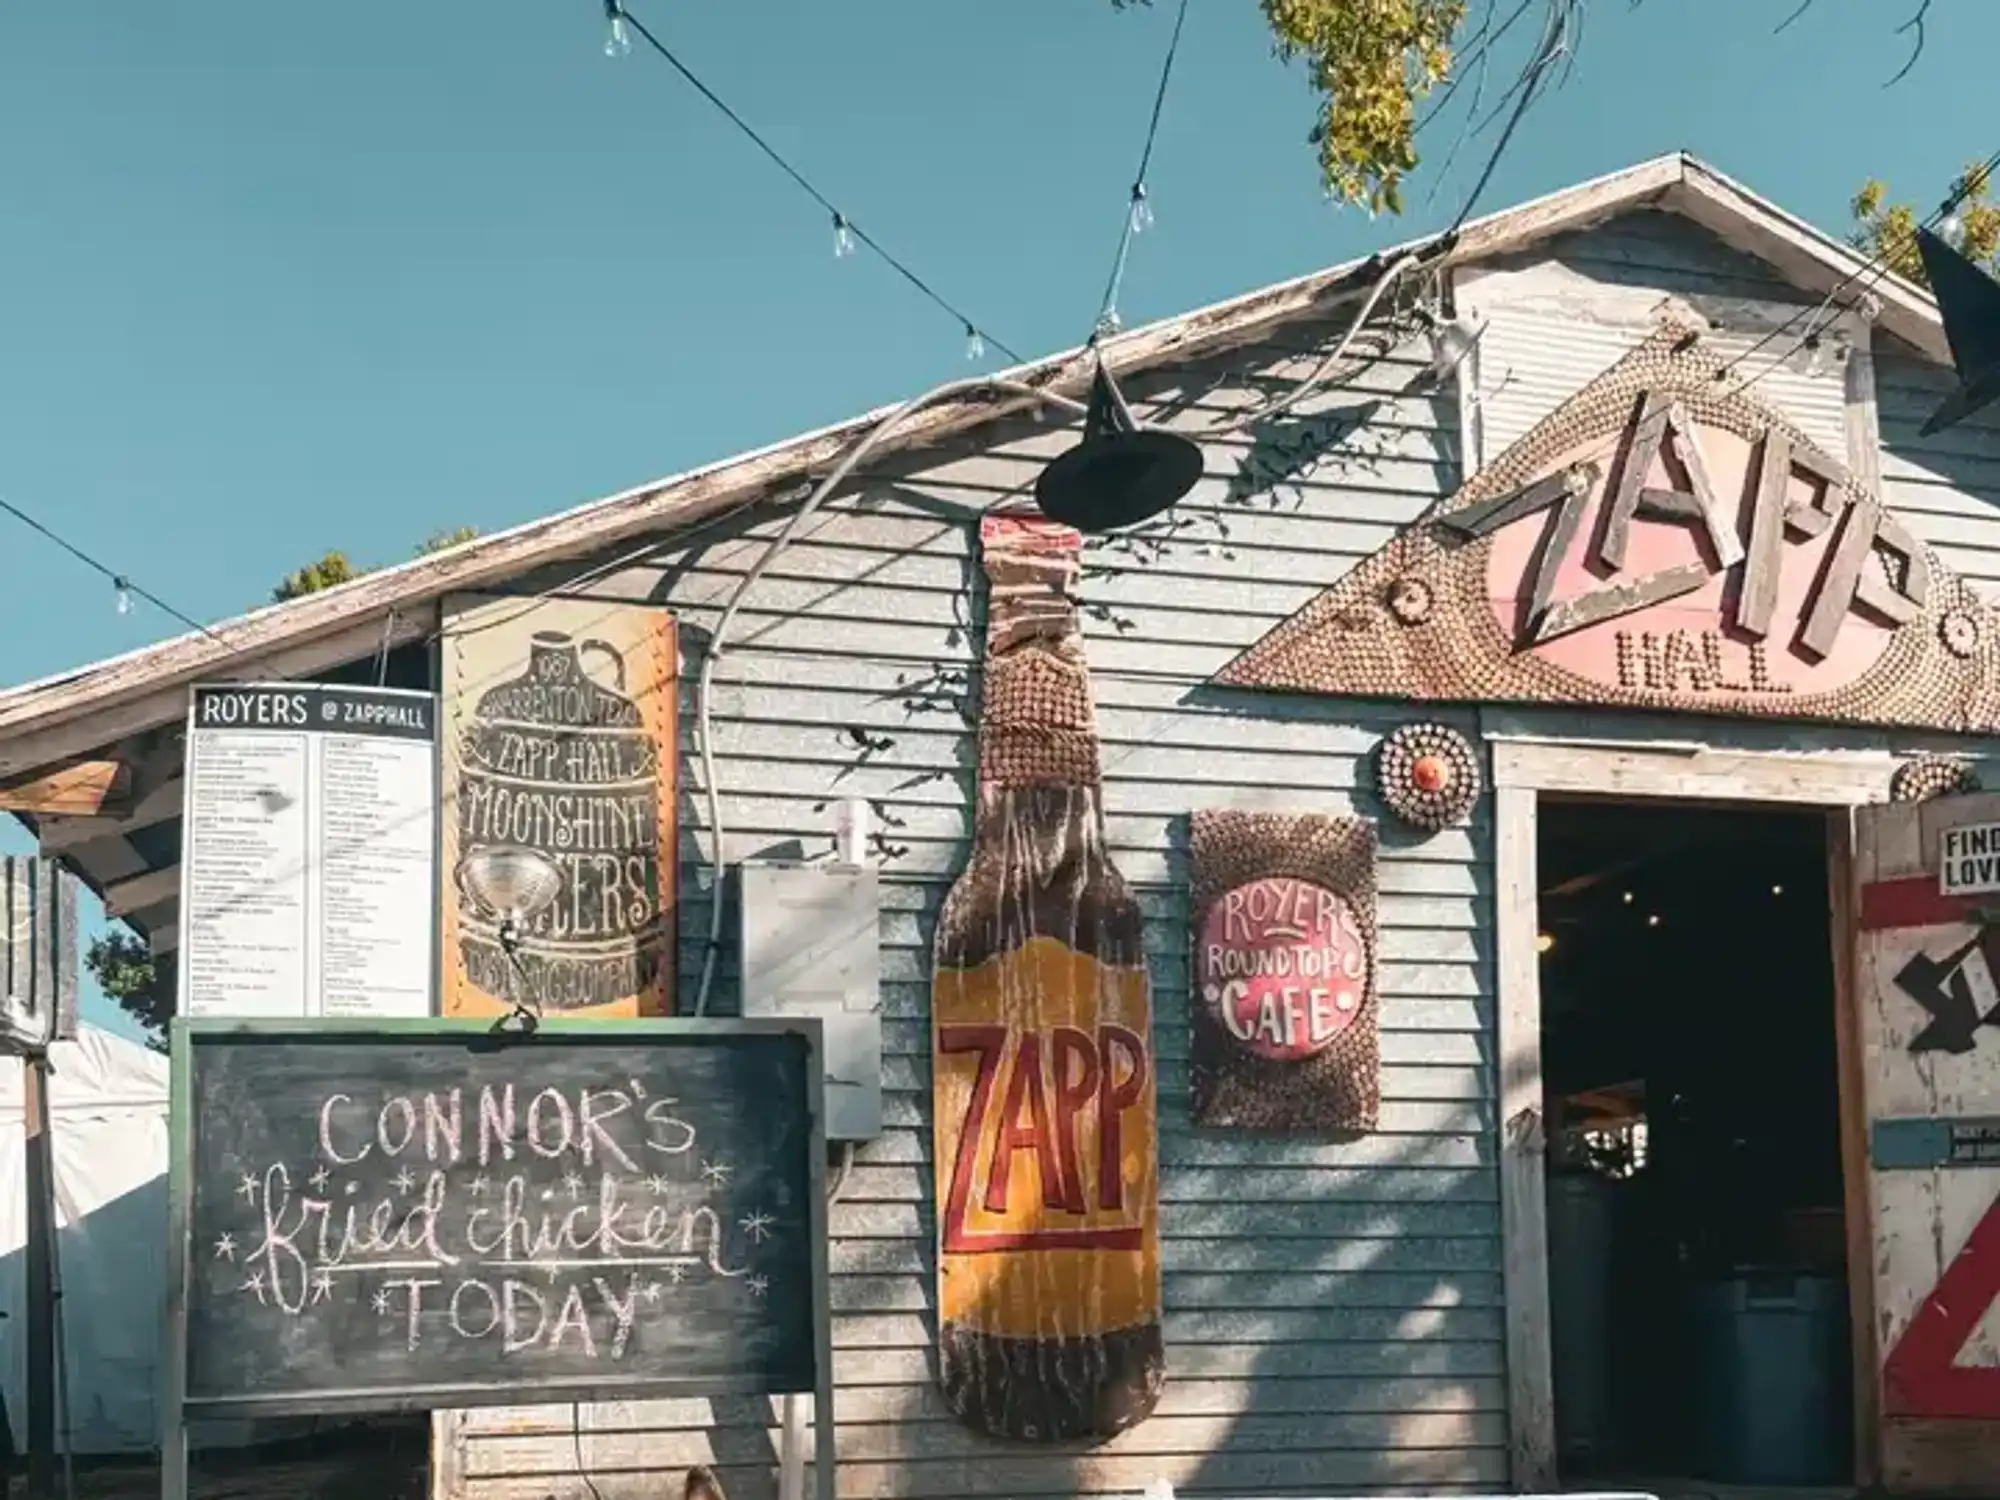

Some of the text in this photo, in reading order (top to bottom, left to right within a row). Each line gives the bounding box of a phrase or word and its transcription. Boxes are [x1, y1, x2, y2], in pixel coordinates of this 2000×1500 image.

[1434, 390, 1930, 662] ZAPP
[1613, 630, 1792, 694] HALL
[204, 694, 426, 729] ROYERS @ ZAPPHALL
[497, 733, 626, 782] ZAPP HALL
[467, 782, 655, 847] MOONSHINE
[1208, 944, 1339, 979] ROUND TOP
[1220, 980, 1340, 1046] CAFE
[939, 1024, 1147, 1255] ZAPP
[246, 1162, 748, 1314] fried chicken
[384, 1272, 641, 1360] TODAY
